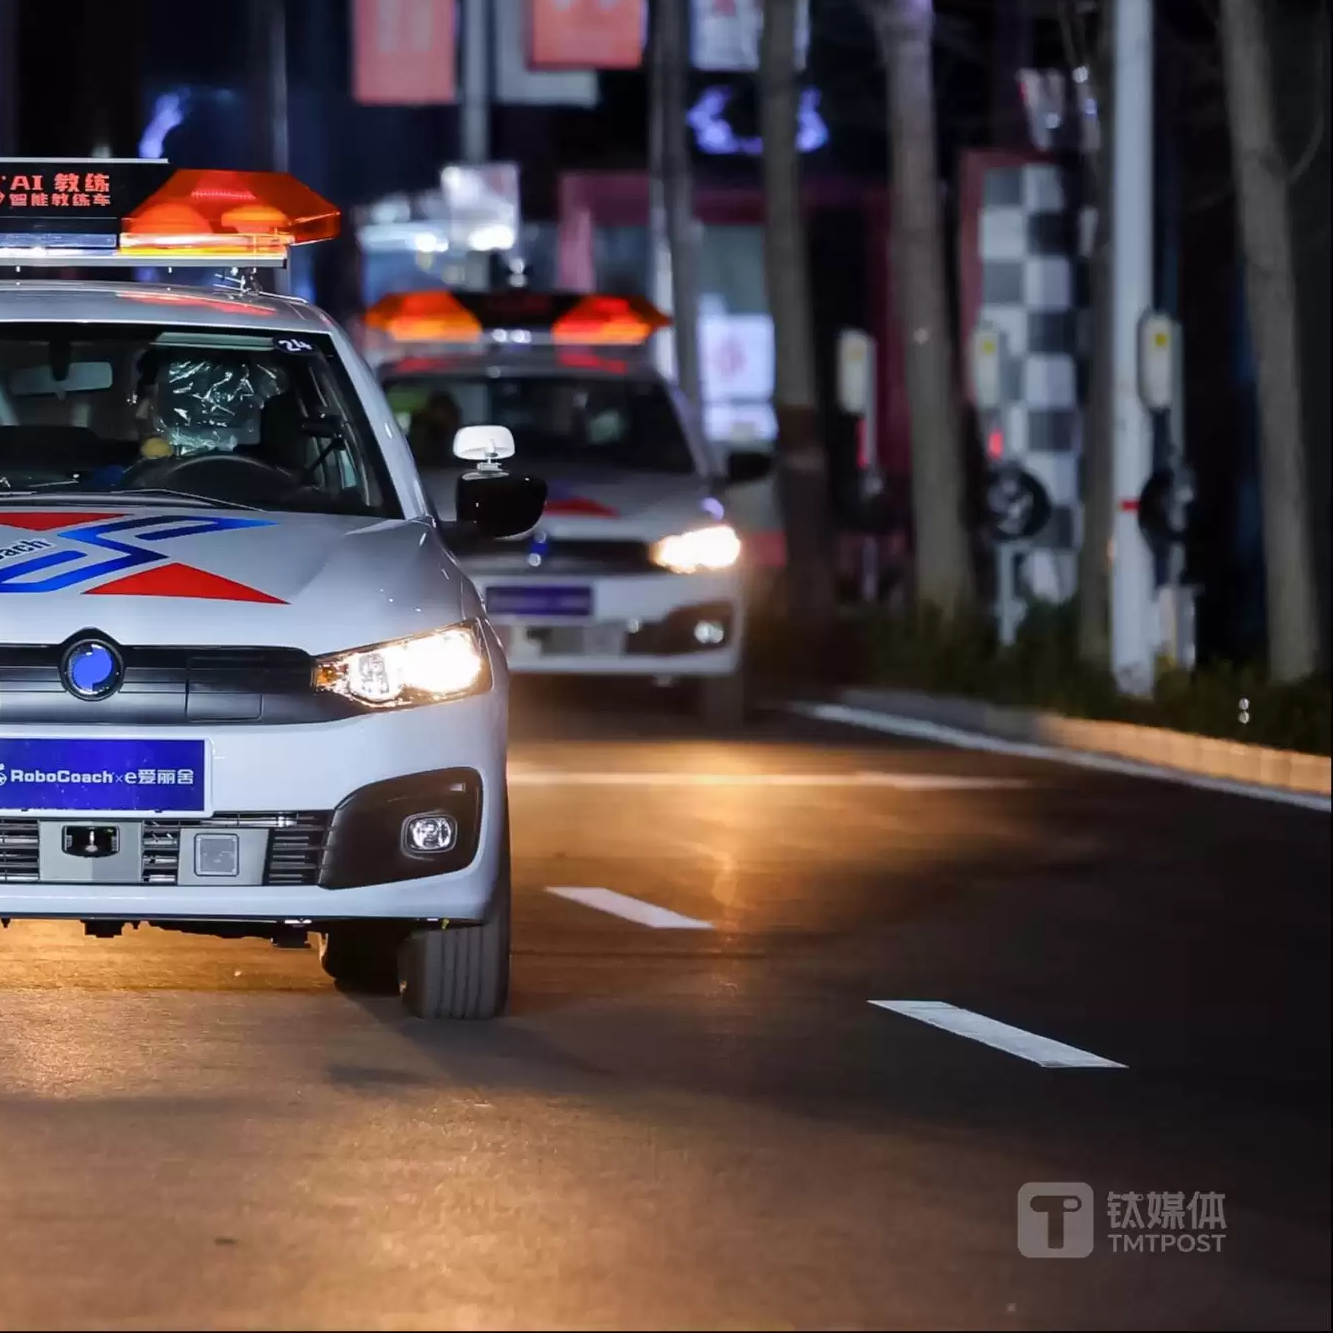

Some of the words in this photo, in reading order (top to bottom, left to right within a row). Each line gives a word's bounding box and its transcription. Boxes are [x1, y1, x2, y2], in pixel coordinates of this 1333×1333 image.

[9, 174, 44, 191] AI
[53, 172, 110, 193] 教练
[8, 192, 112, 207] 智能教练车
[278, 338, 313, 352] 24
[10, 769, 114, 784] RoboCoach
